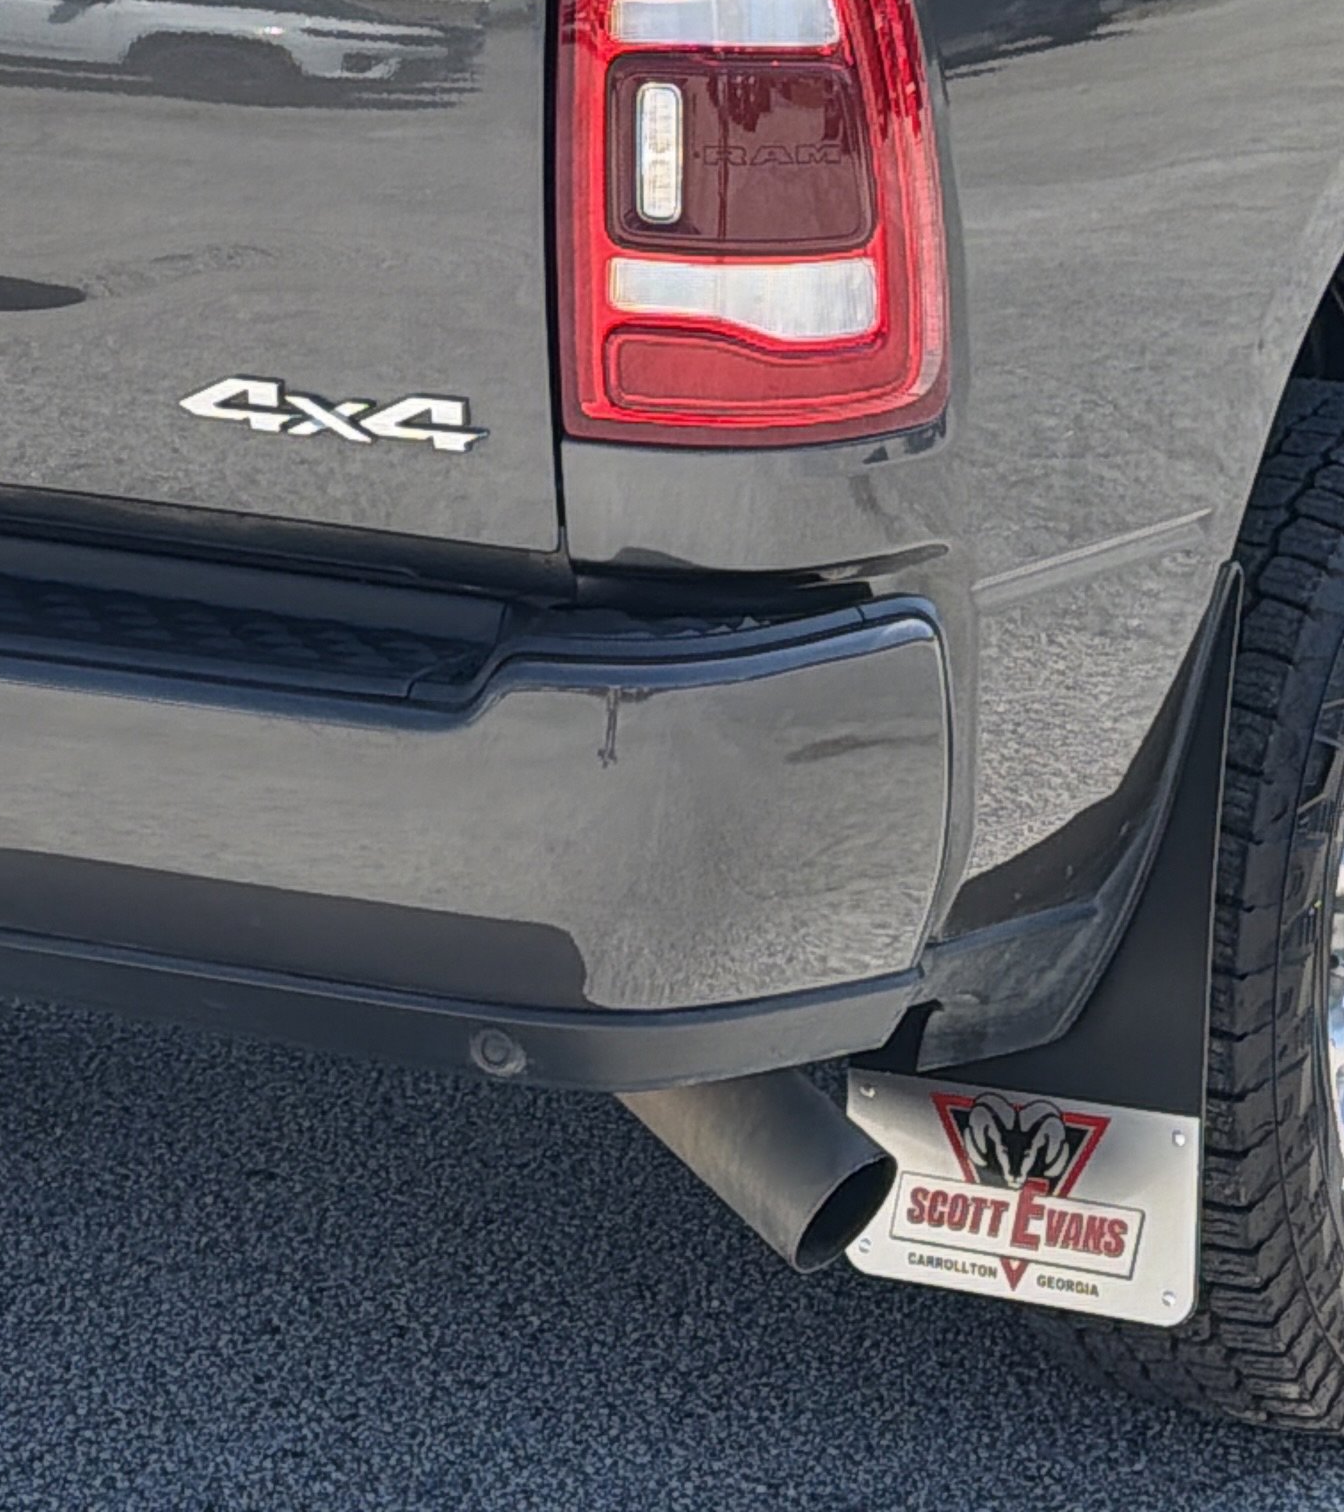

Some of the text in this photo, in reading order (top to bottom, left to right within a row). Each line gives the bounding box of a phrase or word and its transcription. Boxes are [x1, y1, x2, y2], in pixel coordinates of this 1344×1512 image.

[704, 144, 841, 165] RAM
[907, 1178, 1129, 1258] SCOTT EVANS
[907, 1252, 1100, 1298] CARROLLTON GEORGIA
